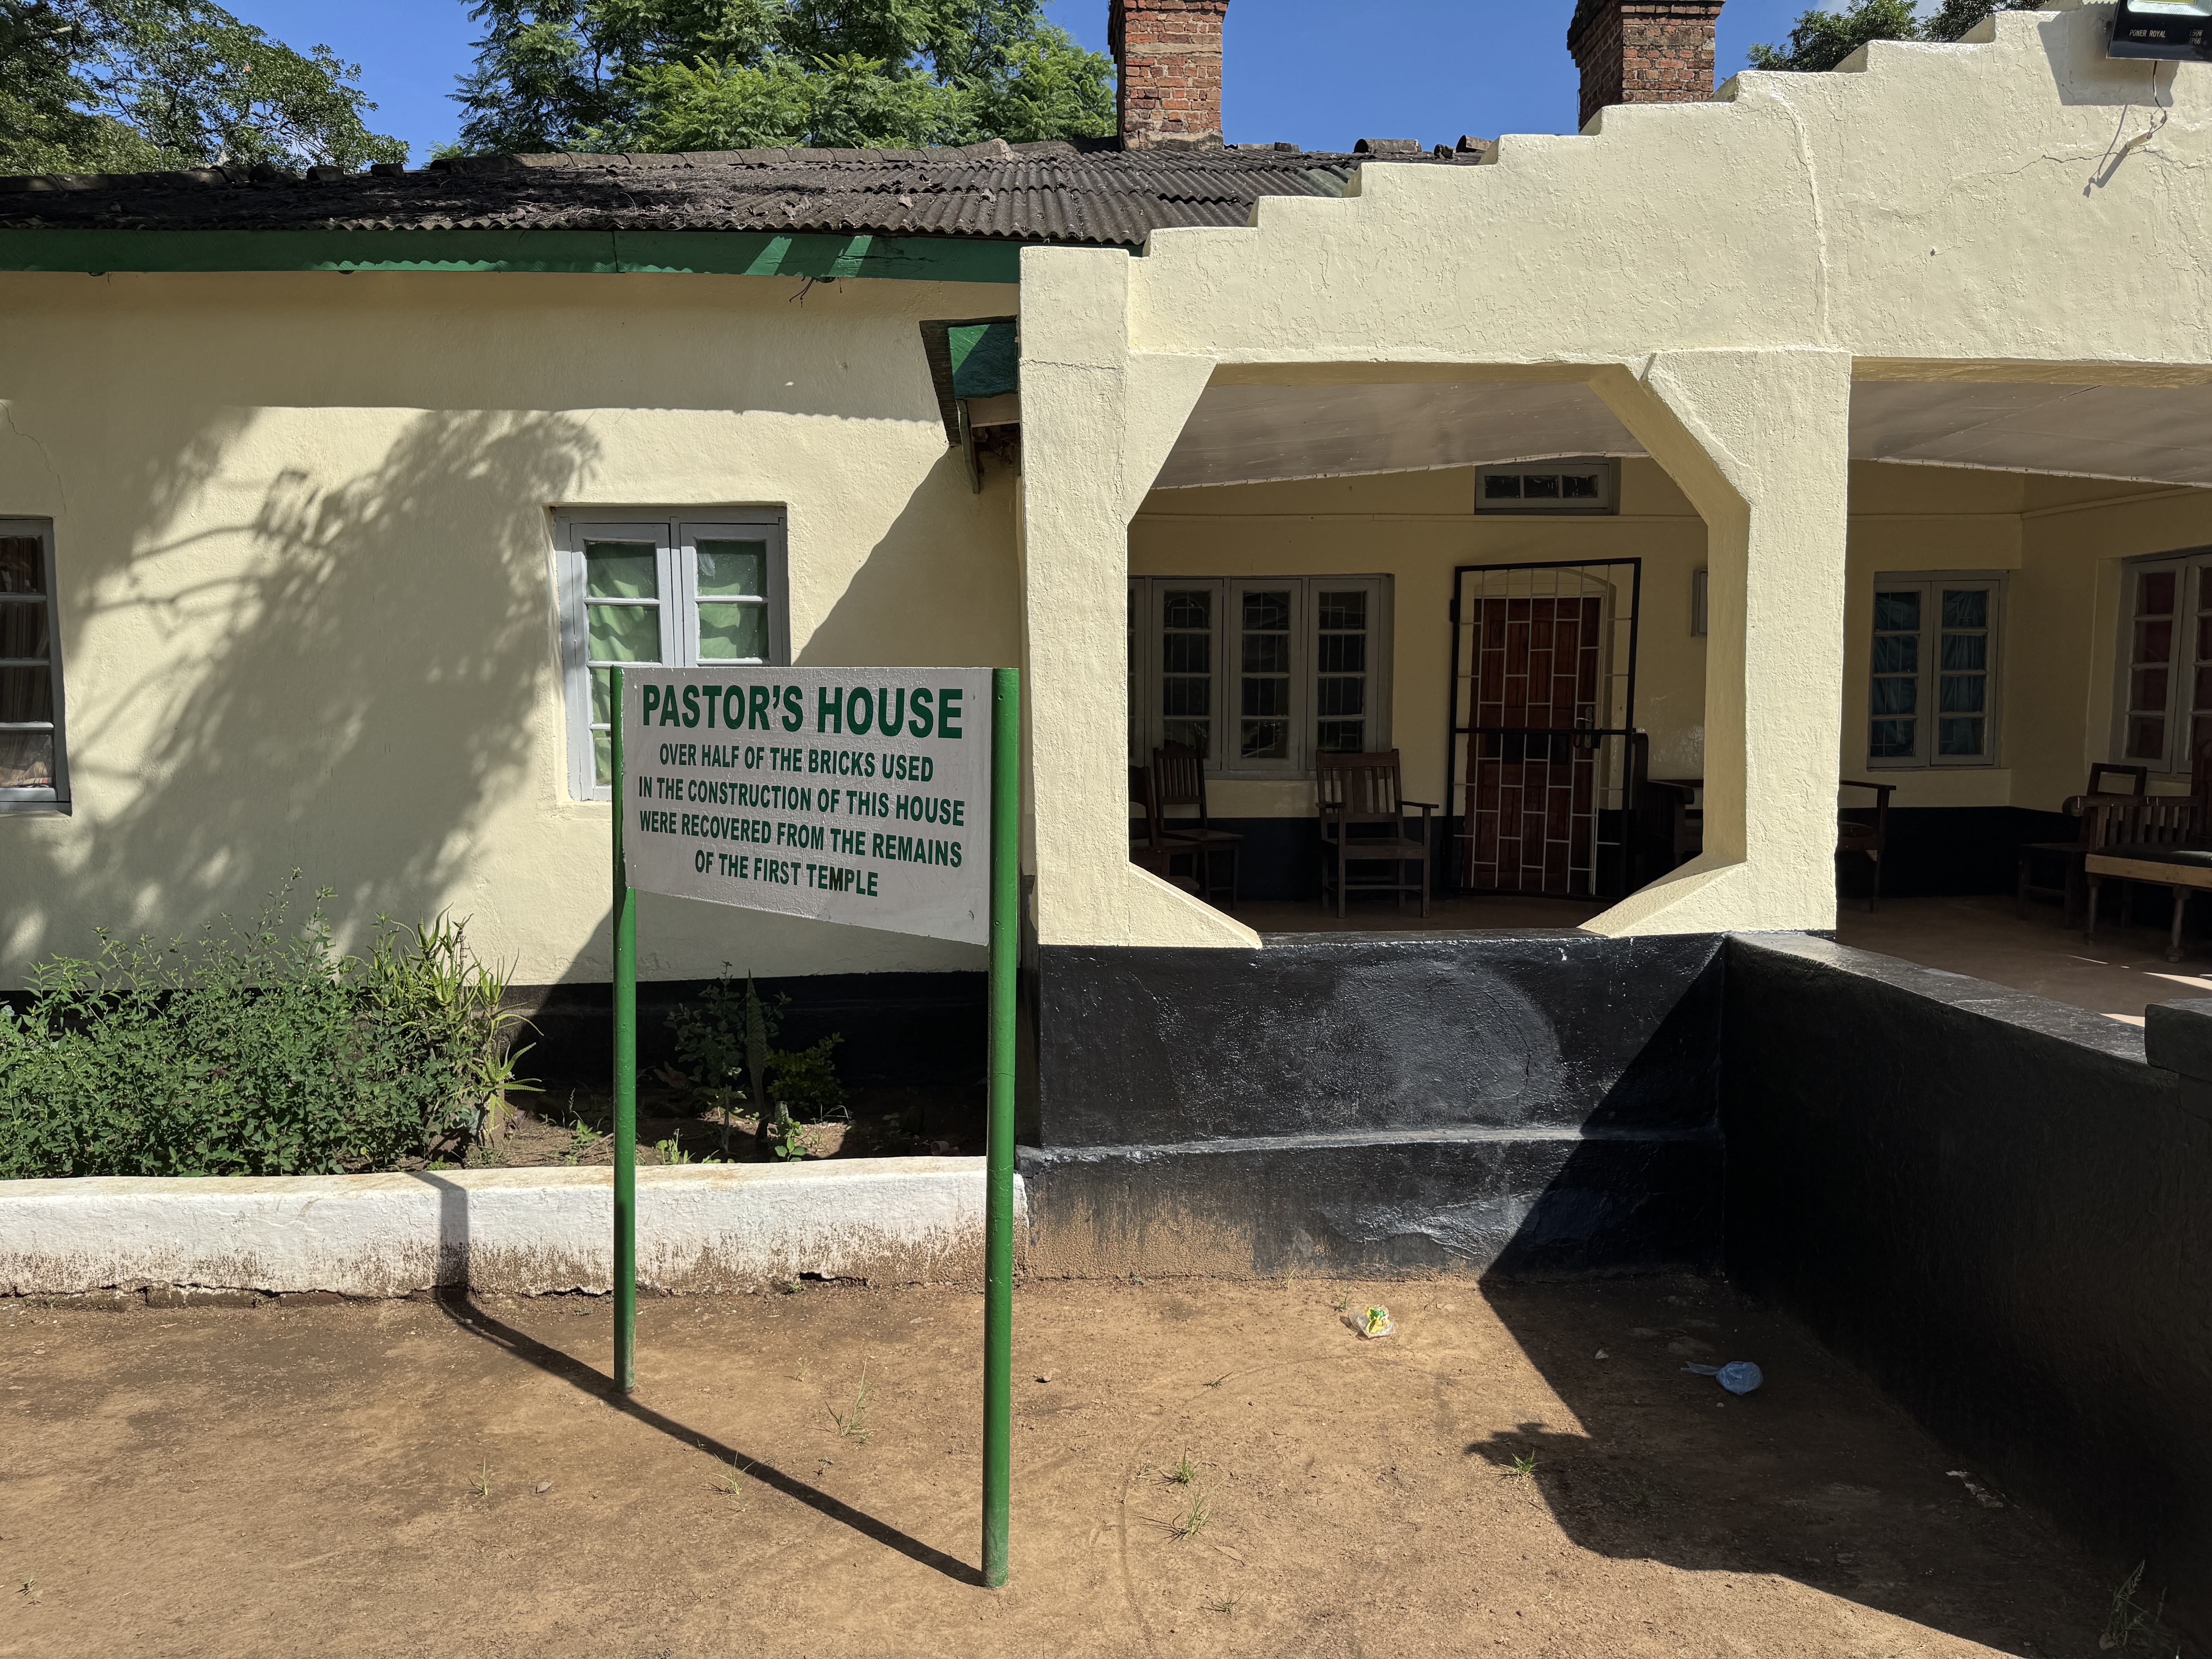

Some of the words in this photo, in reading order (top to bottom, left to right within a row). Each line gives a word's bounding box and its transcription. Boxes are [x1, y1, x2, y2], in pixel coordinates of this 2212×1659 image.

[643, 684, 804, 732] PASTOR'S
[817, 687, 963, 739] HOUSE
[659, 743, 697, 766] OVER
[701, 744, 739, 768] HALF
[744, 746, 765, 769] OF
[770, 747, 803, 772] THE
[808, 749, 875, 778] BRICKS
[882, 753, 933, 782] USED
[639, 776, 652, 798] IN
[656, 777, 684, 801] THE
[688, 779, 811, 811] CONSTRUCTION
[817, 788, 840, 813] OF
[846, 790, 889, 818] THIS
[896, 794, 965, 827] HOUSE
[640, 810, 677, 834] WERE
[681, 813, 771, 844] RECOVERED
[777, 822, 824, 851] FROM
[830, 828, 866, 856] THE
[872, 833, 962, 868] REMAINS
[695, 849, 714, 874] OF
[718, 853, 749, 879] THE
[754, 857, 801, 886] FIRST
[806, 863, 878, 897] TEMPLE
